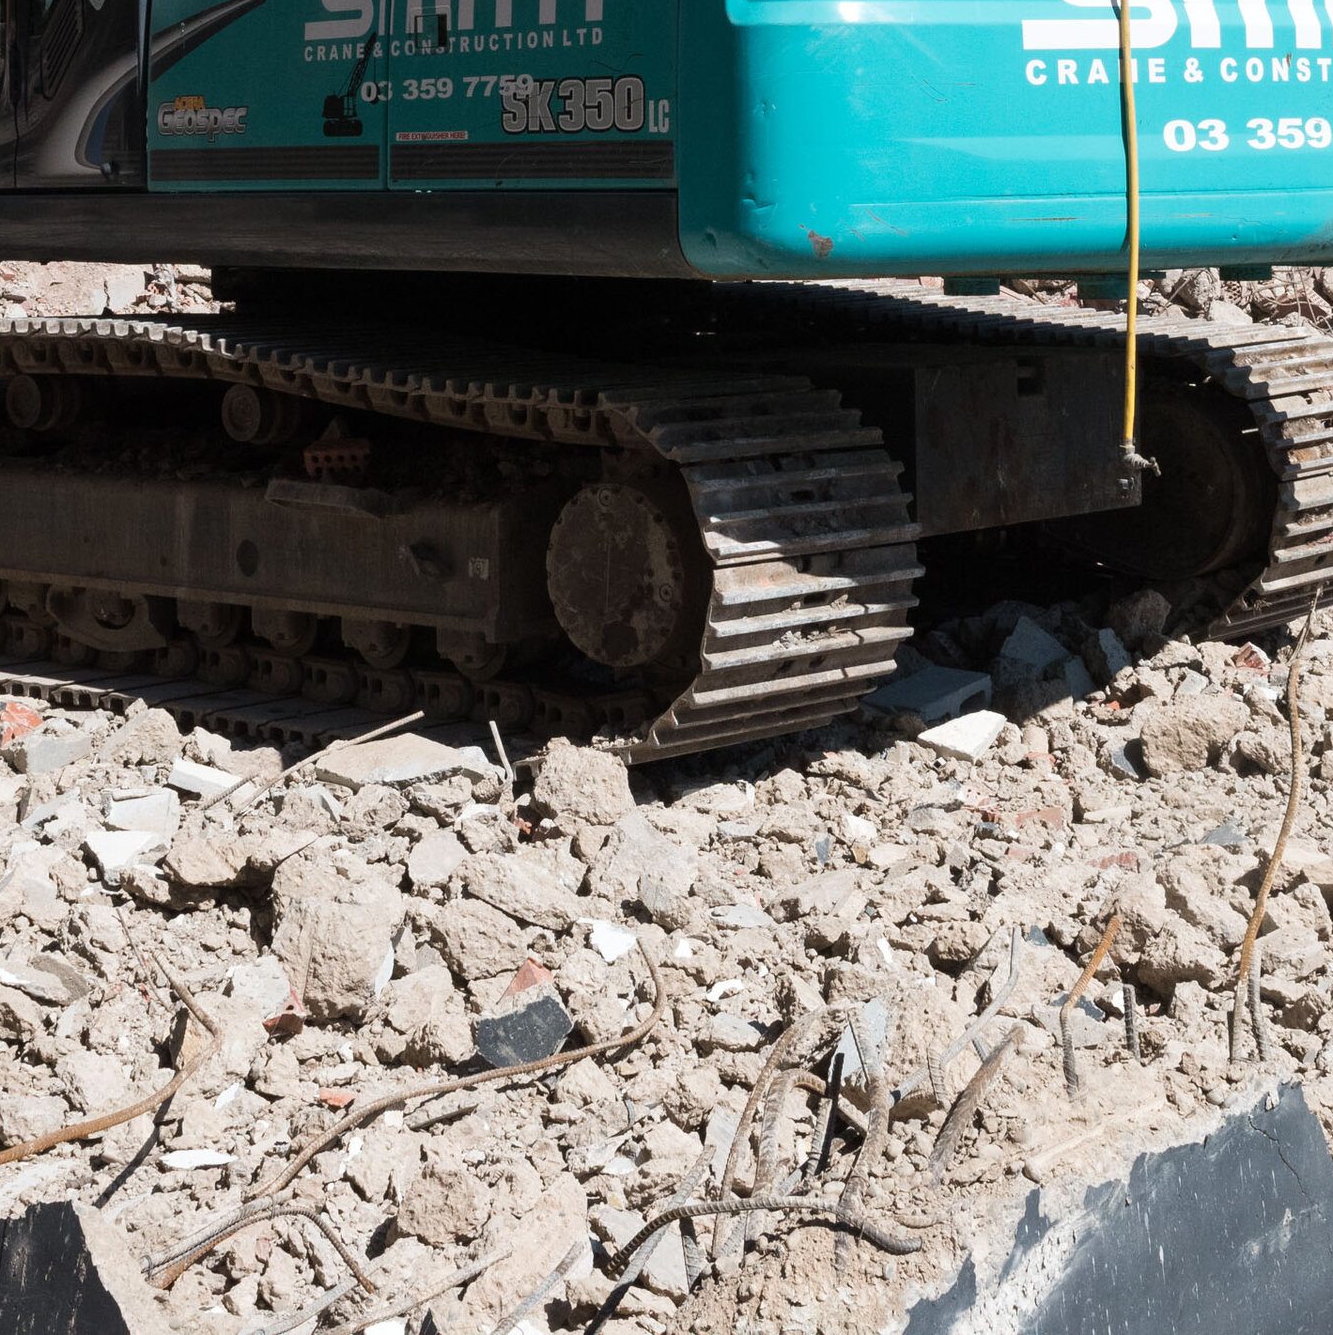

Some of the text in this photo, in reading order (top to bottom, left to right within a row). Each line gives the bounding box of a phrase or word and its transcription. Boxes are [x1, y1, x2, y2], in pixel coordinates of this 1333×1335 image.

[304, 42, 366, 62] CRANE
[373, 41, 384, 58] &
[562, 27, 603, 47] LTD
[1184, 57, 1204, 83] &
[360, 74, 534, 102] 03 359 7759
[501, 74, 669, 134] SK350 LC
[1164, 118, 1230, 151] 03
[1246, 117, 1333, 149] 359
